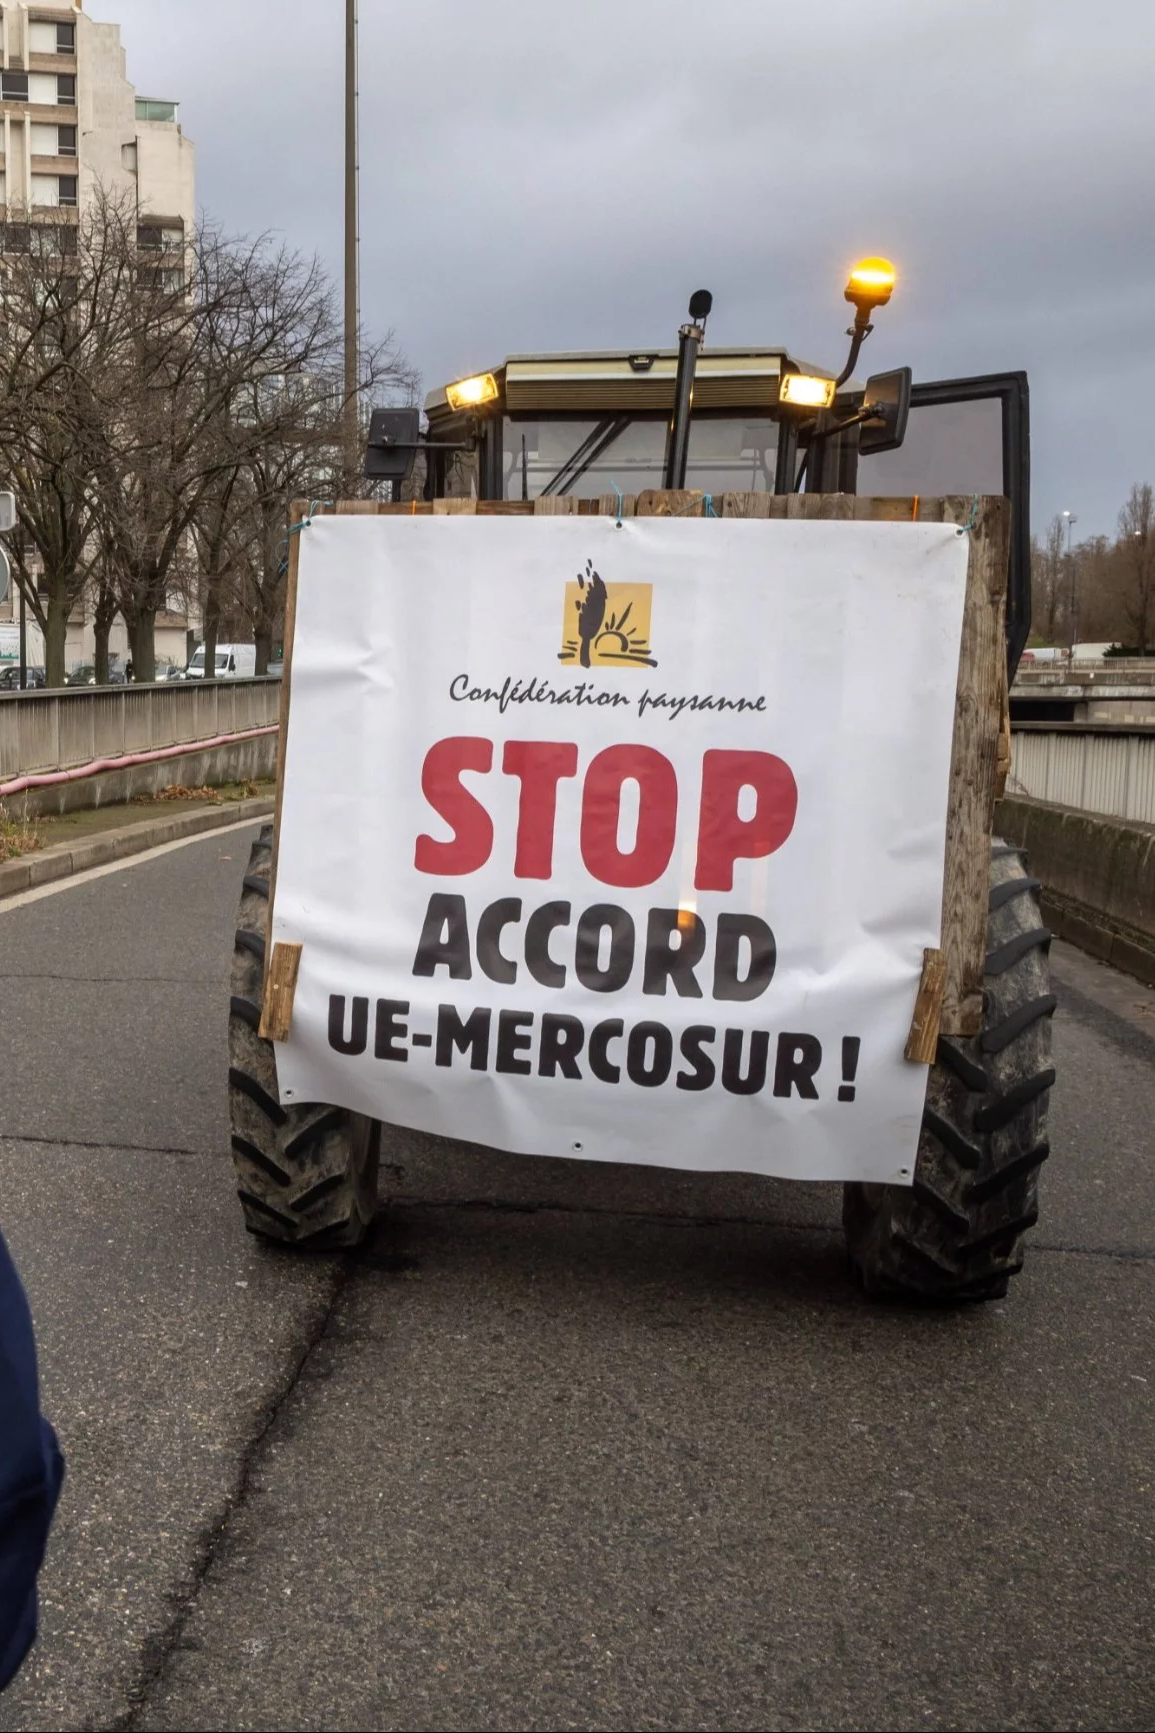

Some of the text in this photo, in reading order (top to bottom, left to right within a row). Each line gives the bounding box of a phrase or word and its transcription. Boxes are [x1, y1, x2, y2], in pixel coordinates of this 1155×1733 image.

[449, 674, 767, 720] Confédération paysanne
[414, 736, 798, 892] STOP
[412, 893, 777, 1002] ACCORD
[327, 994, 823, 1101] UE-MERCOSUR
